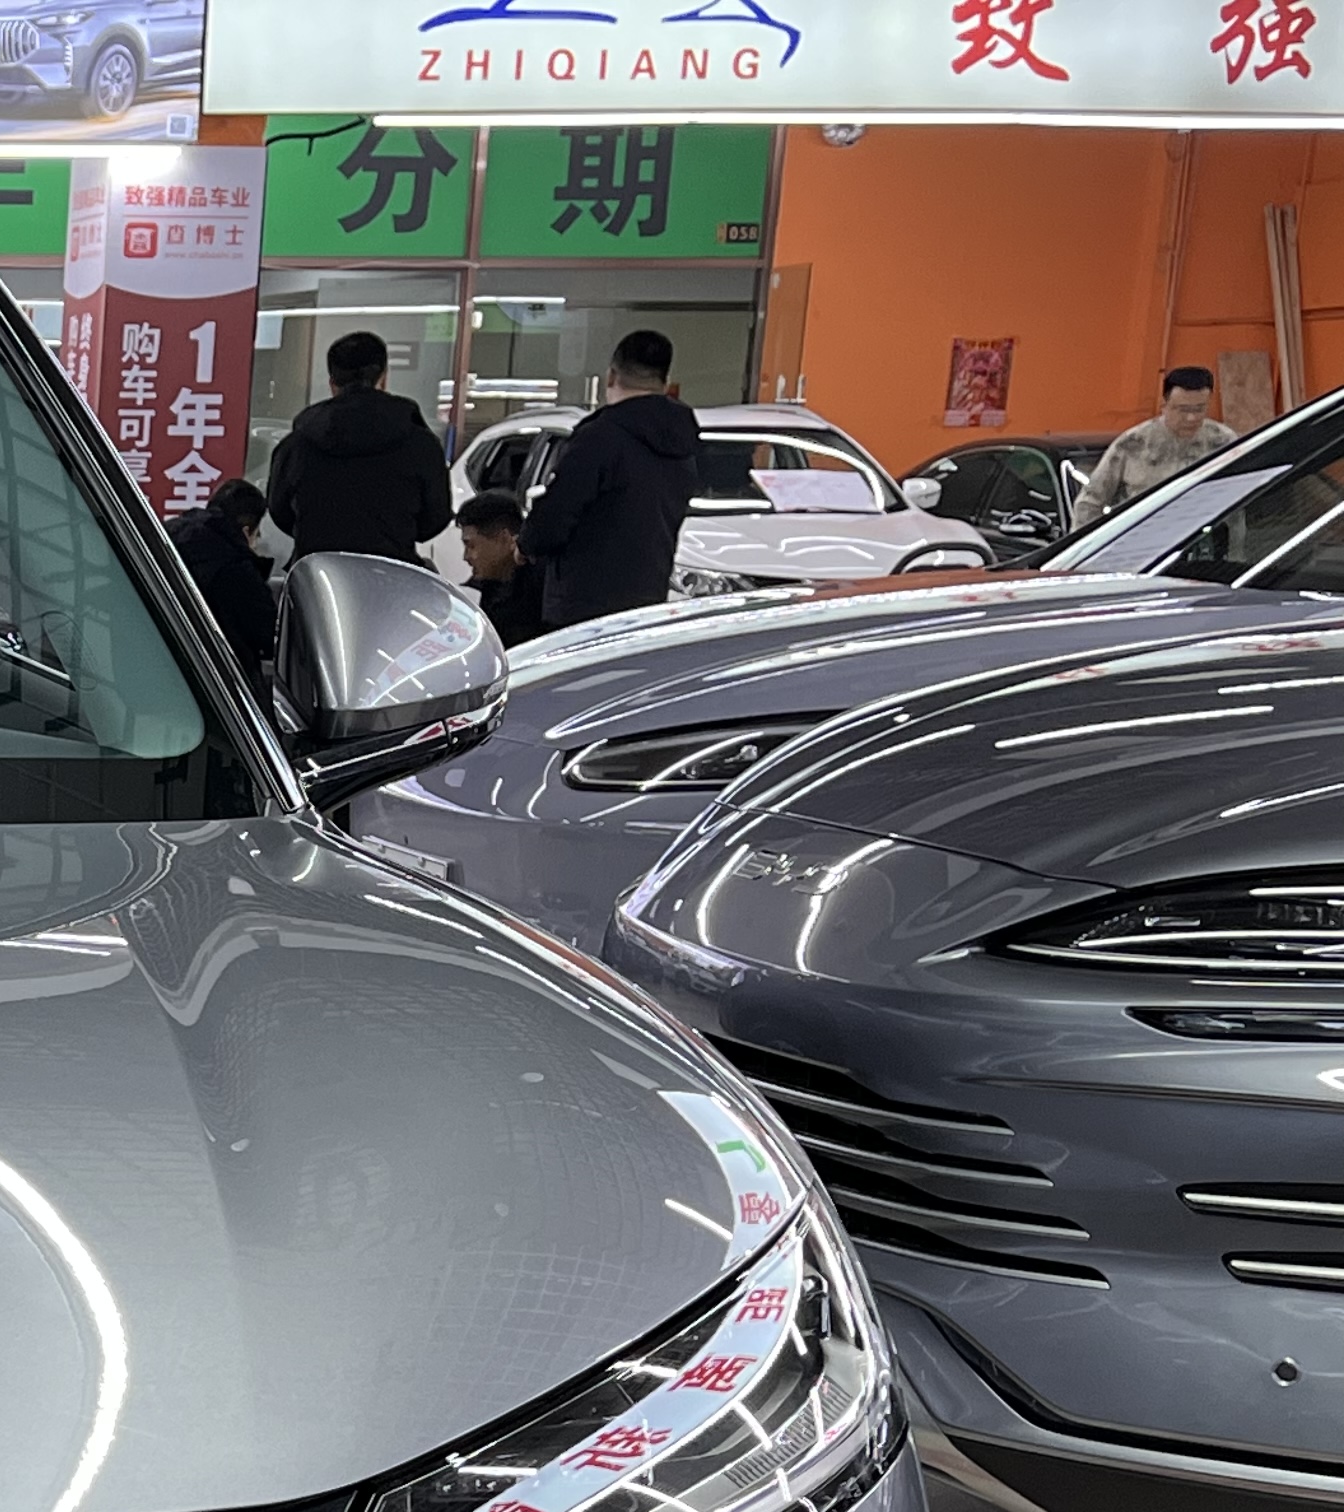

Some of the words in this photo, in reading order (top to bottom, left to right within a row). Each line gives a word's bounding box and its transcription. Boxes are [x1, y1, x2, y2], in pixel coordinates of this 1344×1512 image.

[418, 48, 760, 81] ZHIQIANG
[124, 184, 251, 208] 致强精品车业
[165, 224, 245, 246] 查博士
[118, 321, 161, 498] 购车可享
[164, 320, 226, 518] 1年全
